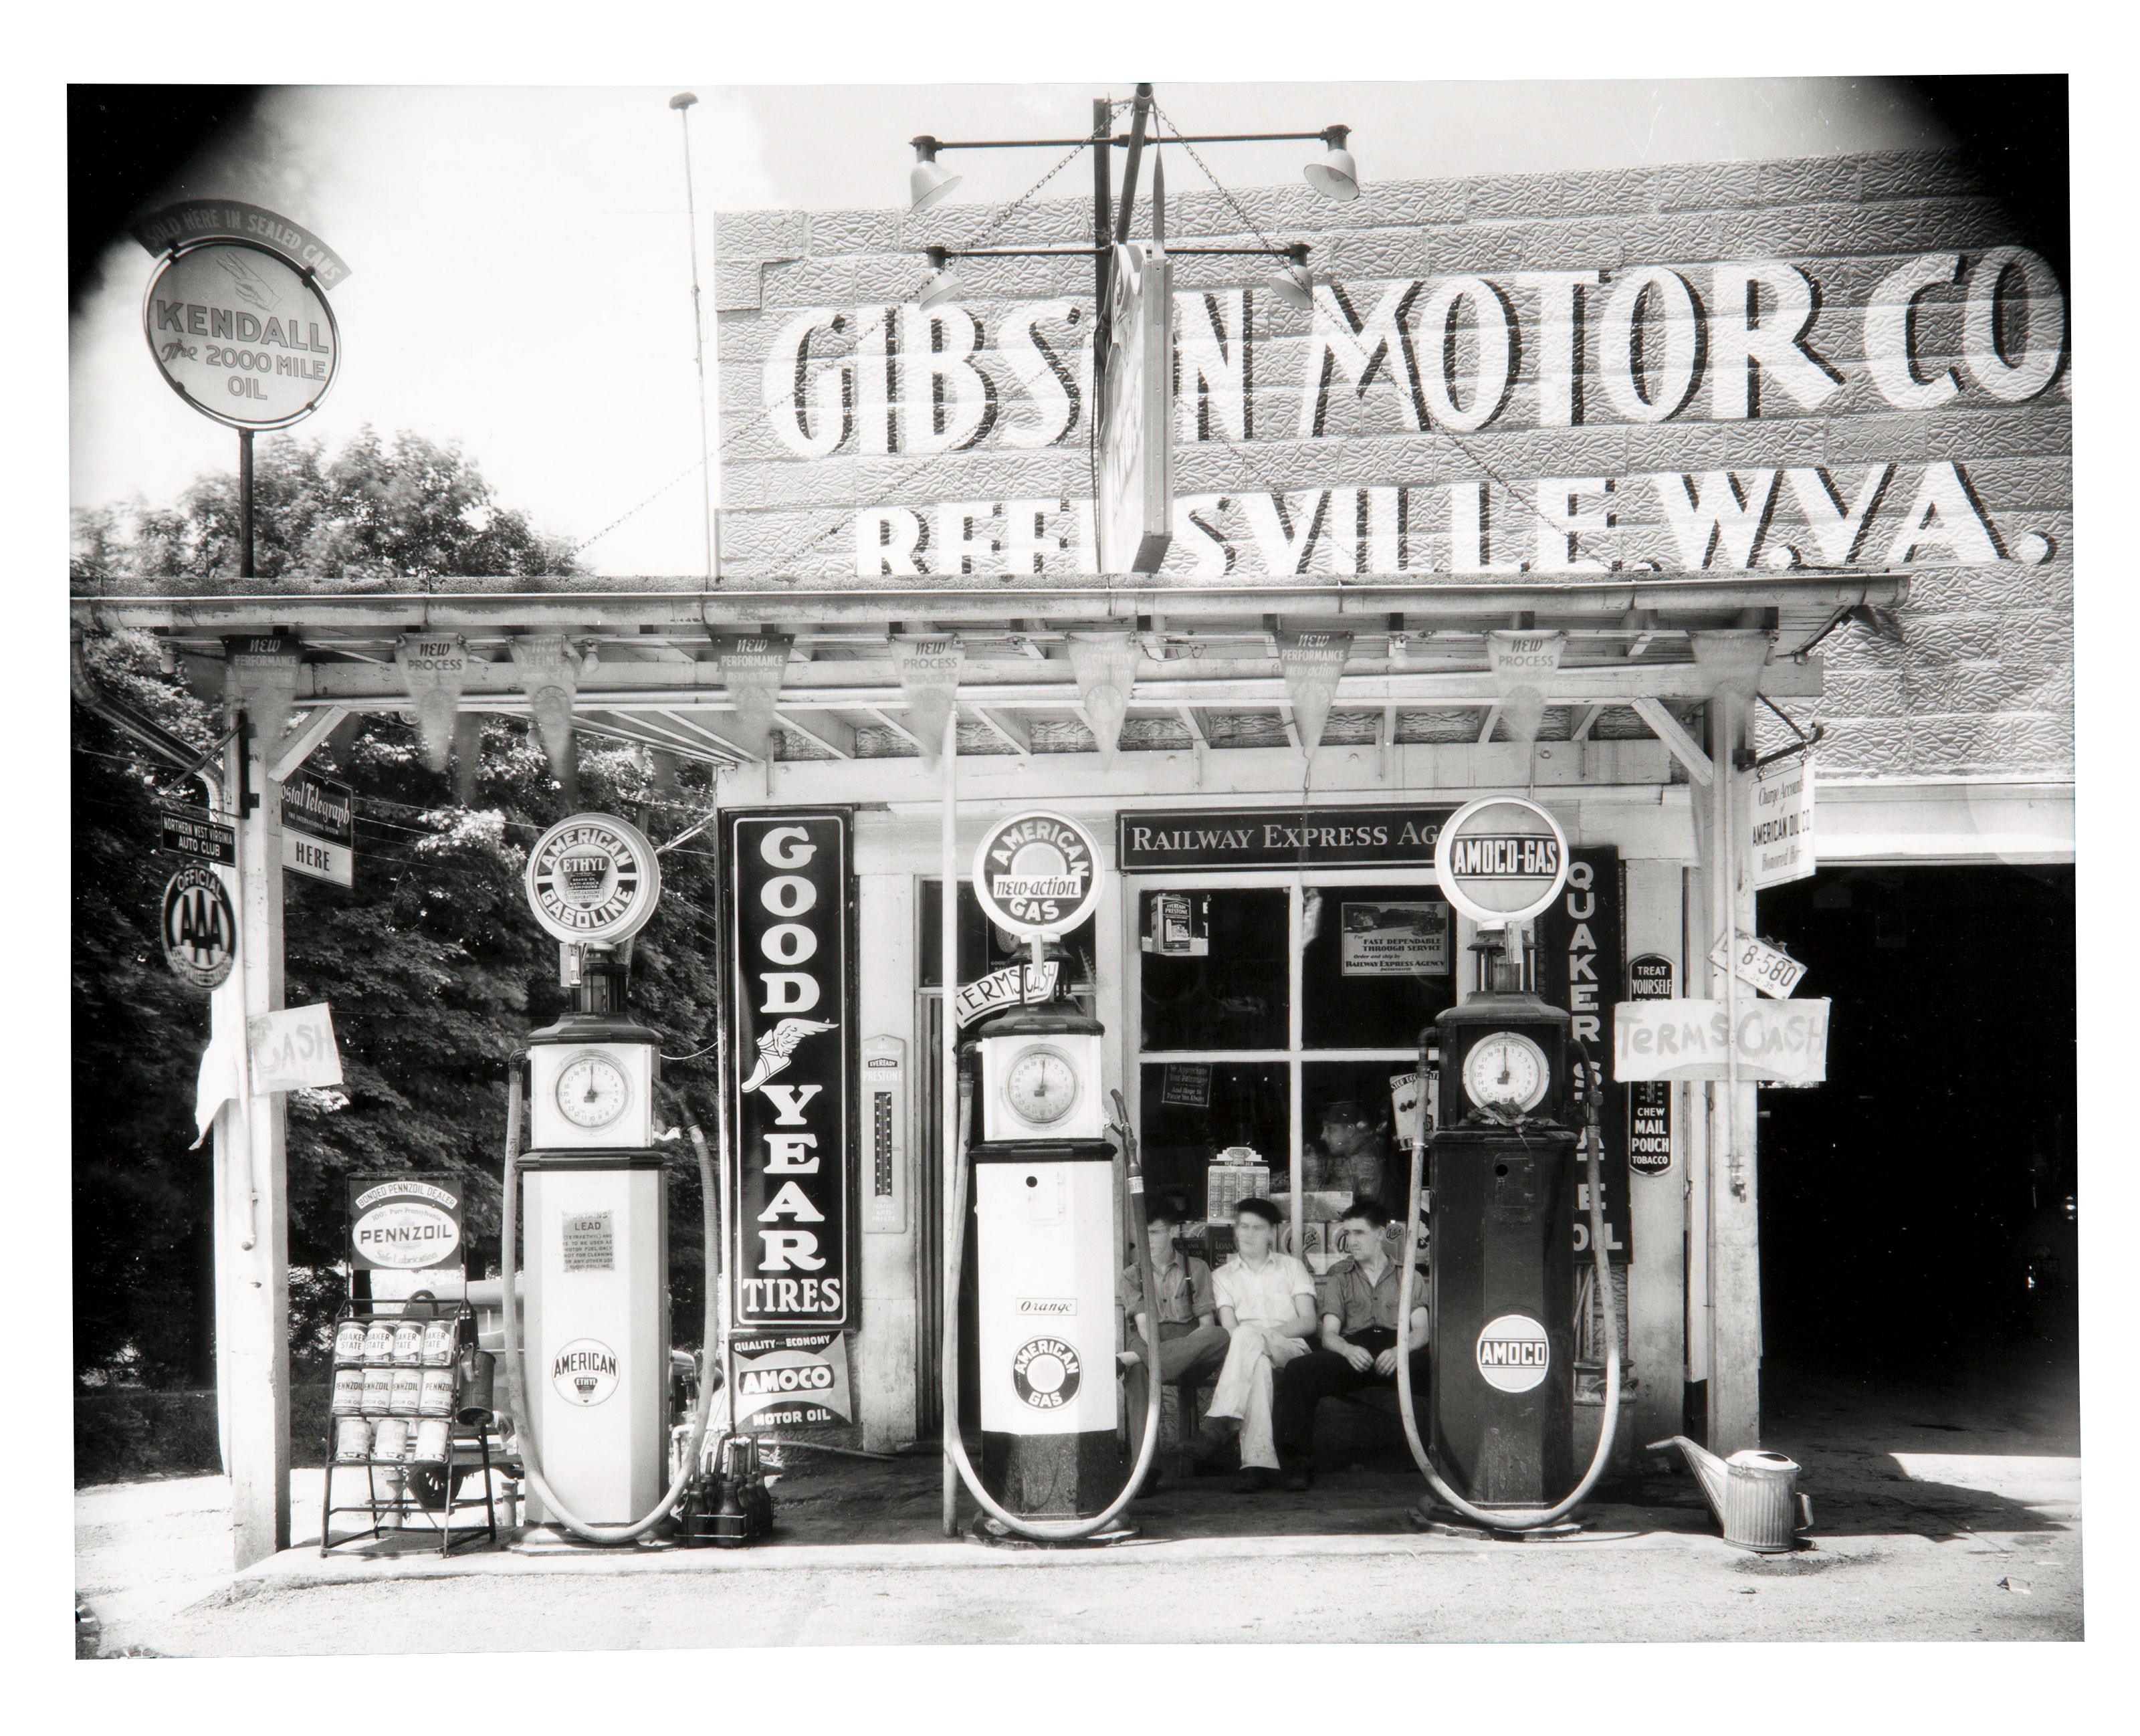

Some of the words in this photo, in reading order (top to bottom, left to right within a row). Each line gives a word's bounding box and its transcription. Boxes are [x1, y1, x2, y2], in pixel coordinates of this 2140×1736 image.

[183, 209, 221, 231] HERE
[225, 209, 241, 229] IN
[247, 213, 302, 250] SEALED
[302, 244, 342, 281] CANS
[156, 300, 329, 354] KENDALL
[161, 338, 199, 362] The
[206, 345, 272, 372] 2000
[277, 355, 326, 381] MILE
[763, 290, 1253, 458] GIBSN
[1297, 264, 1848, 438] MOTOR
[228, 376, 268, 400] OIL
[856, 477, 1620, 575] REESVILLE
[249, 639, 281, 653] NEW
[419, 643, 450, 657] NEW
[737, 639, 768, 653] NEW
[916, 642, 946, 655] NEW
[1297, 635, 1329, 648] NEW
[1511, 639, 1543, 653] NEW
[235, 655, 296, 667] PERFORMANCE
[721, 655, 783, 667] PERFORMANCE
[903, 657, 958, 669] PROCESS
[1282, 649, 1344, 662] PERFORMANCE
[1498, 655, 1555, 667] PROCESS
[408, 659, 463, 671] PROCESS
[281, 781, 306, 807] ostal
[306, 782, 350, 828] Telegraph
[1759, 787, 1780, 808] Charge
[163, 817, 192, 837] NORTHERN
[193, 825, 207, 839] WEST
[209, 829, 233, 846] VIRGINIA
[1132, 827, 1255, 851] RAILWAY
[1263, 823, 1388, 849] EXPRESS
[1752, 817, 1788, 847] AMERICAN
[1790, 812, 1800, 837] OIL
[178, 836, 199, 852] AUTO
[201, 842, 221, 857] CLUB
[540, 829, 633, 869] AMERICAN
[992, 821, 1090, 877] AMERICAN
[296, 841, 330, 872] HERE
[562, 857, 607, 872] ETHYL
[1454, 840, 1557, 874] AMOCO-GAS
[177, 869, 223, 901] OFFICIAL
[996, 877, 1080, 897] new-action
[540, 887, 634, 928] GASOLINE
[1009, 897, 1059, 921] GAS
[180, 889, 223, 967] AAA
[1024, 964, 1058, 994] CASH
[1637, 966, 1667, 976] TREAT
[1632, 979, 1672, 995] YOURSELF
[863, 1070, 903, 1082] PRESTONE
[1391, 1079, 1404, 1090] STOP
[1637, 1107, 1665, 1117] CHEW
[1634, 1119, 1667, 1135] MAIL
[1631, 1137, 1670, 1154] POUCH
[1632, 1156, 1669, 1165] TOBACCO
[358, 1186, 387, 1206] BONDED
[389, 1183, 424, 1195] PENNZOIL
[427, 1186, 455, 1206] DEALER
[405, 1207, 442, 1222] Pennsylvania
[360, 1224, 453, 1244] PENNZOIL
[574, 1222, 601, 1231] LEAD
[742, 1278, 841, 1313] TIRES
[1021, 1301, 1072, 1314] Orange
[339, 1332, 366, 1341] QUAKER
[734, 1339, 776, 1352] QUALITY
[786, 1335, 831, 1347] ECONOMY
[341, 1341, 362, 1350] STATE
[1481, 1343, 1545, 1365] AMOCO
[554, 1352, 616, 1379] AMERICAN
[1014, 1339, 1079, 1375] AMERICAN
[336, 1382, 364, 1391] PENNZOIL
[576, 1378, 597, 1386] ETHYL
[742, 1366, 832, 1395] AMOCO
[1028, 1391, 1063, 1408] GAS
[752, 1411, 802, 1426] MOTOR
[807, 1408, 831, 1422] OIL
